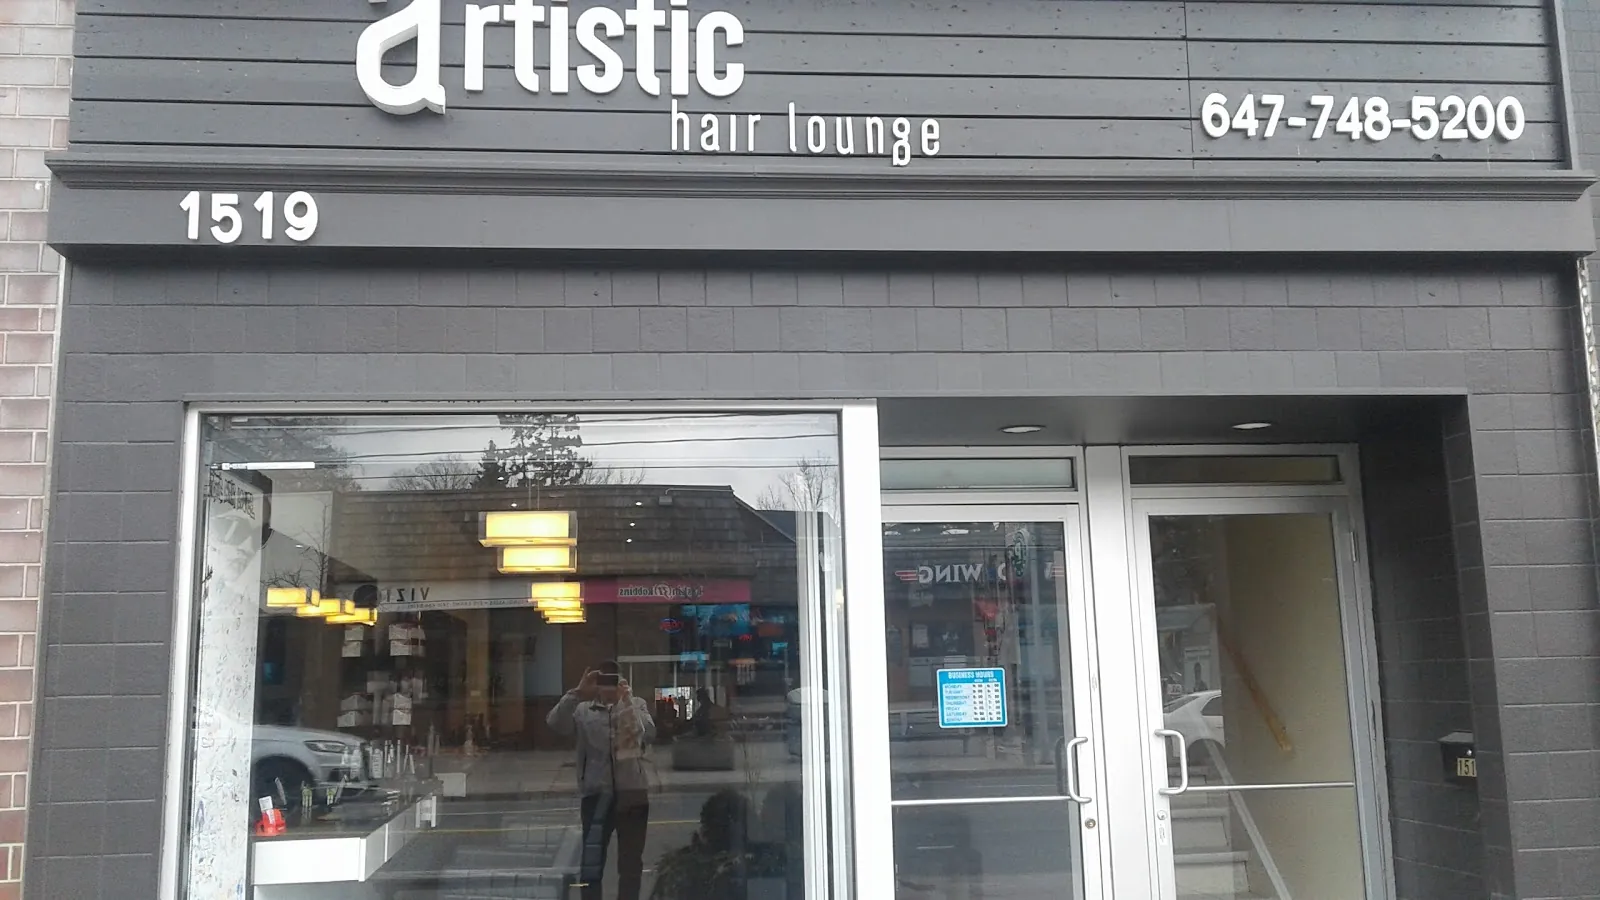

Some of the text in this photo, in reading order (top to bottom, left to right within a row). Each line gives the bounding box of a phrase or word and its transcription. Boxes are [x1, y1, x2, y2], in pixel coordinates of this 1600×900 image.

[355, 0, 745, 115] artistic
[670, 99, 942, 166] hair lounge
[1202, 92, 1526, 141] 647-748-5200
[179, 190, 319, 244] 1519
